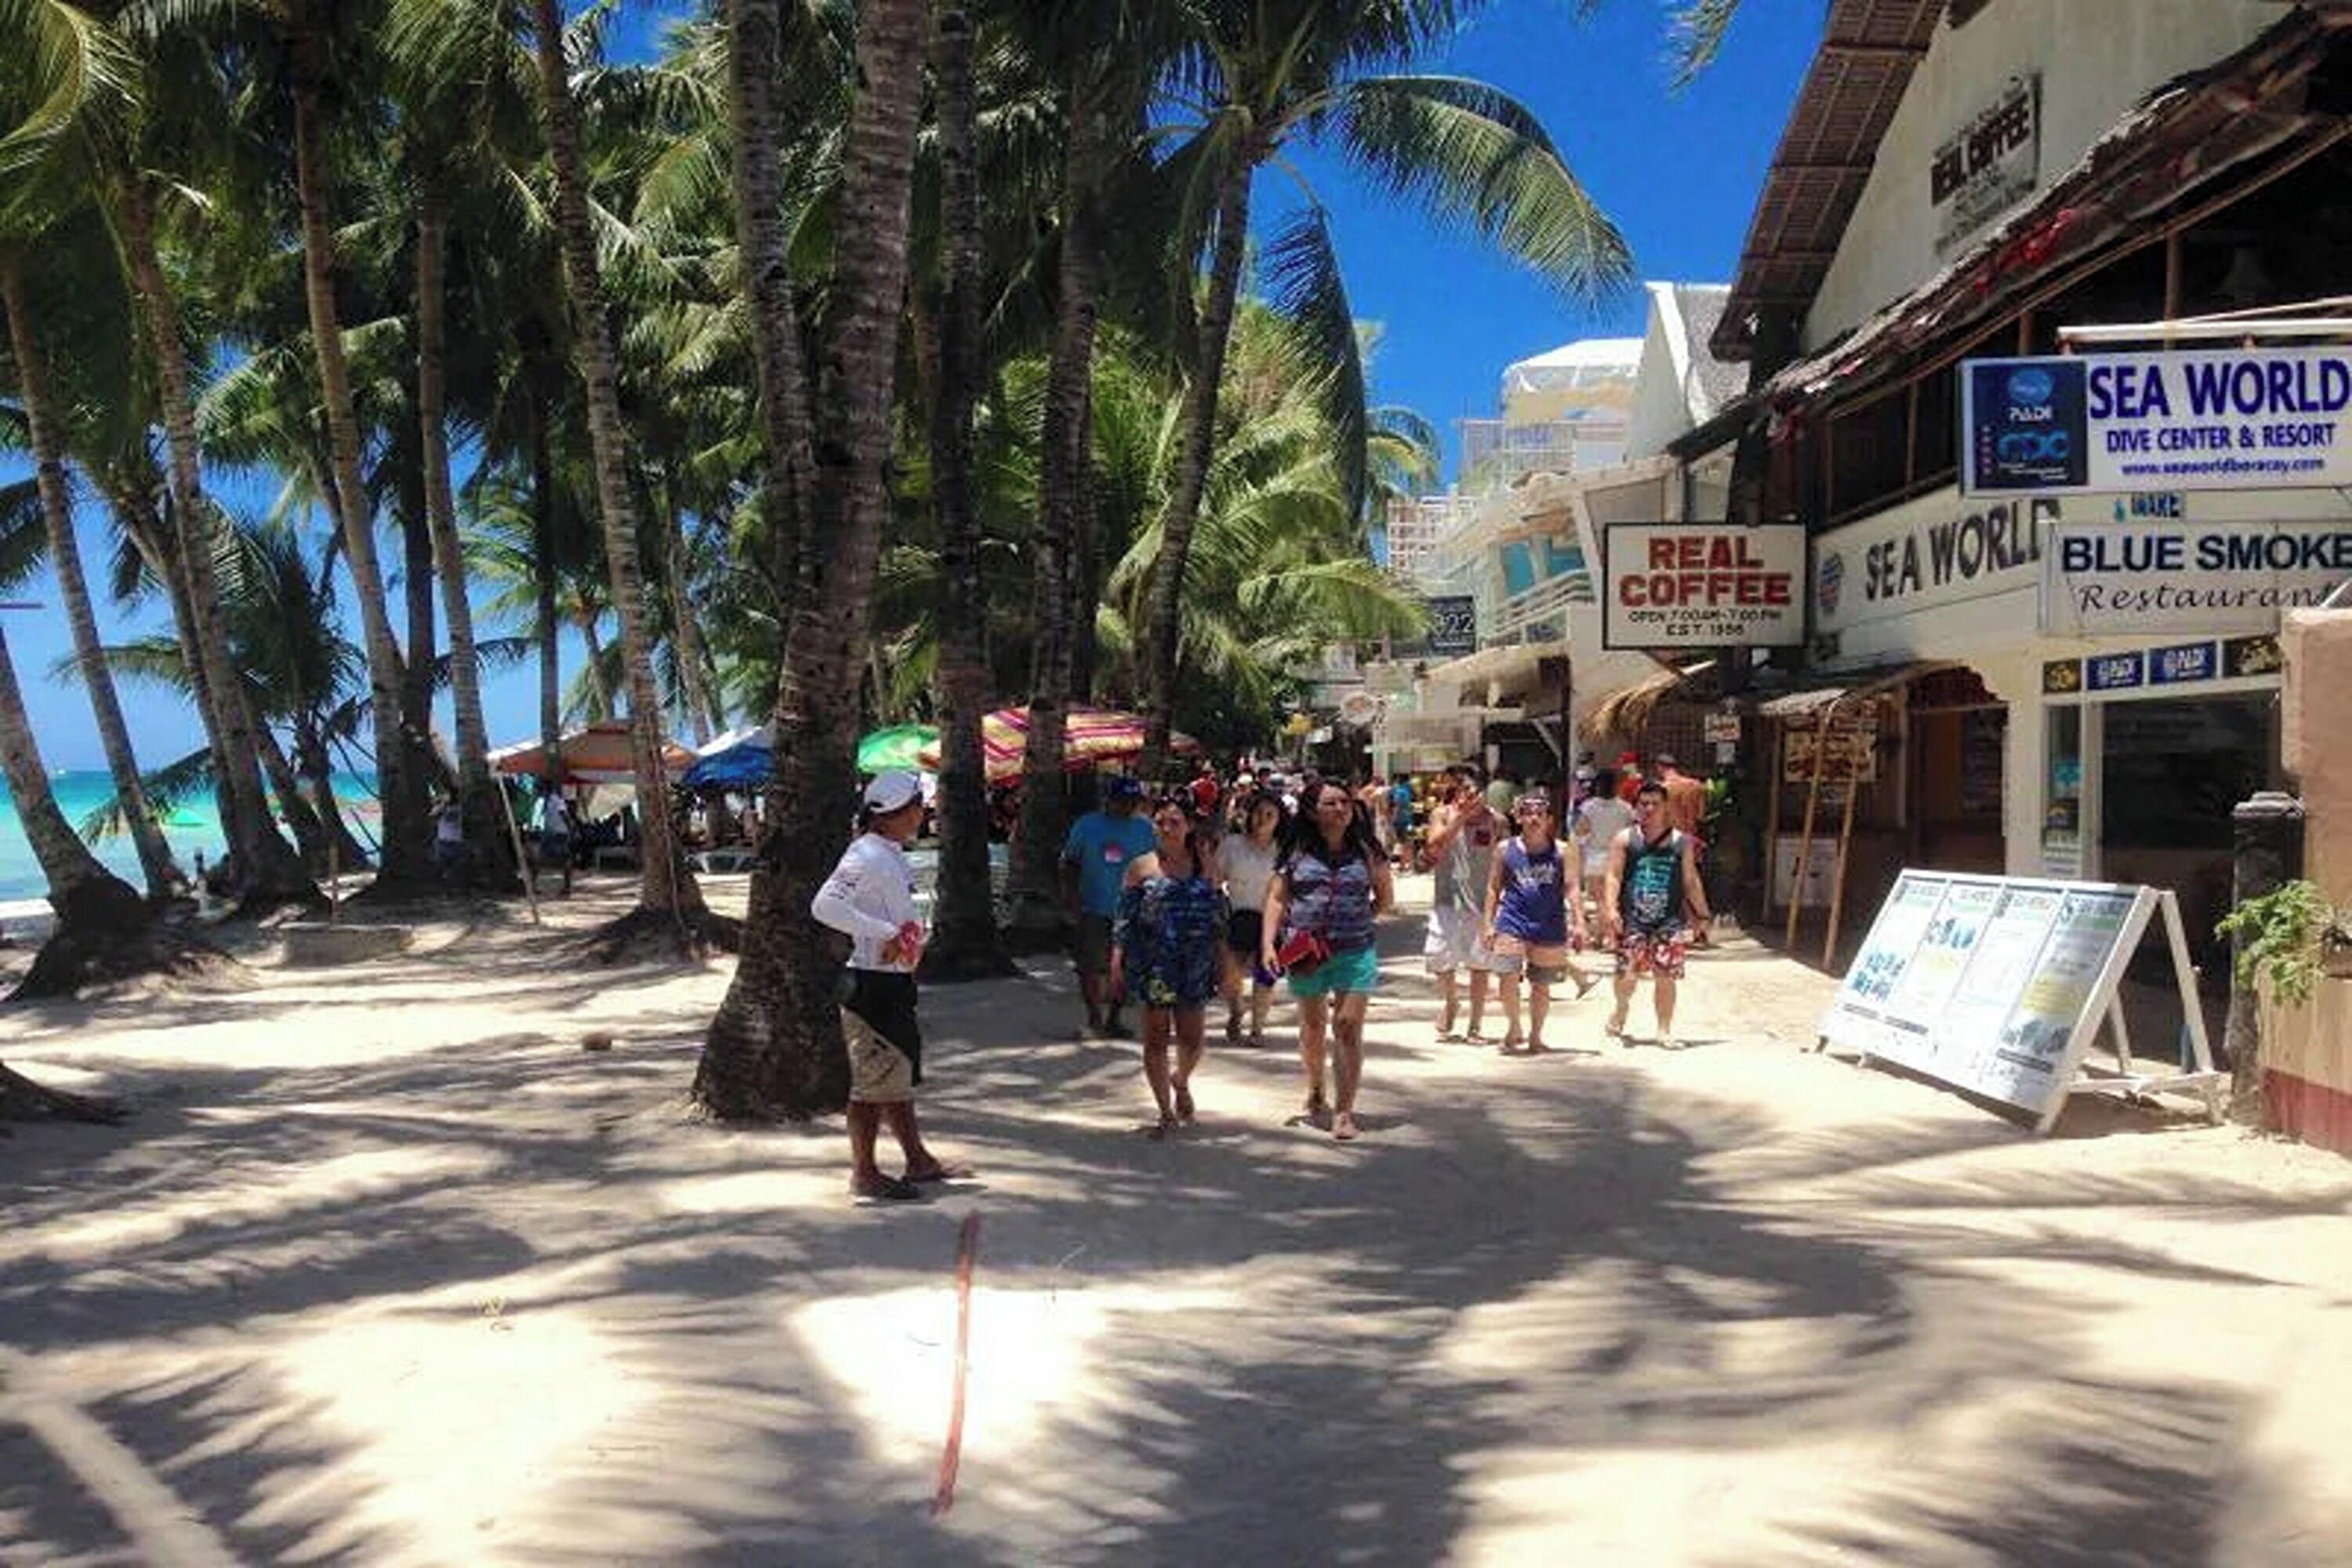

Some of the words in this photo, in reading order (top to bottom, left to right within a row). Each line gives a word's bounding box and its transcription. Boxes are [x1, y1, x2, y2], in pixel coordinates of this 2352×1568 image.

[2089, 365, 2170, 419] SEA
[2184, 359, 2350, 416] WORLD
[2107, 430, 2150, 452] DIVE
[2158, 426, 2231, 451] CENTER
[2240, 426, 2255, 448] &
[2263, 423, 2336, 448] RESORT
[1649, 536, 1764, 570] REAL
[1866, 535, 1922, 601] SEA
[2062, 535, 2185, 572] BLUE
[2195, 533, 2352, 570] SMOKE
[1620, 572, 1791, 607] COFFEE
[1628, 611, 1668, 622] OPEN
